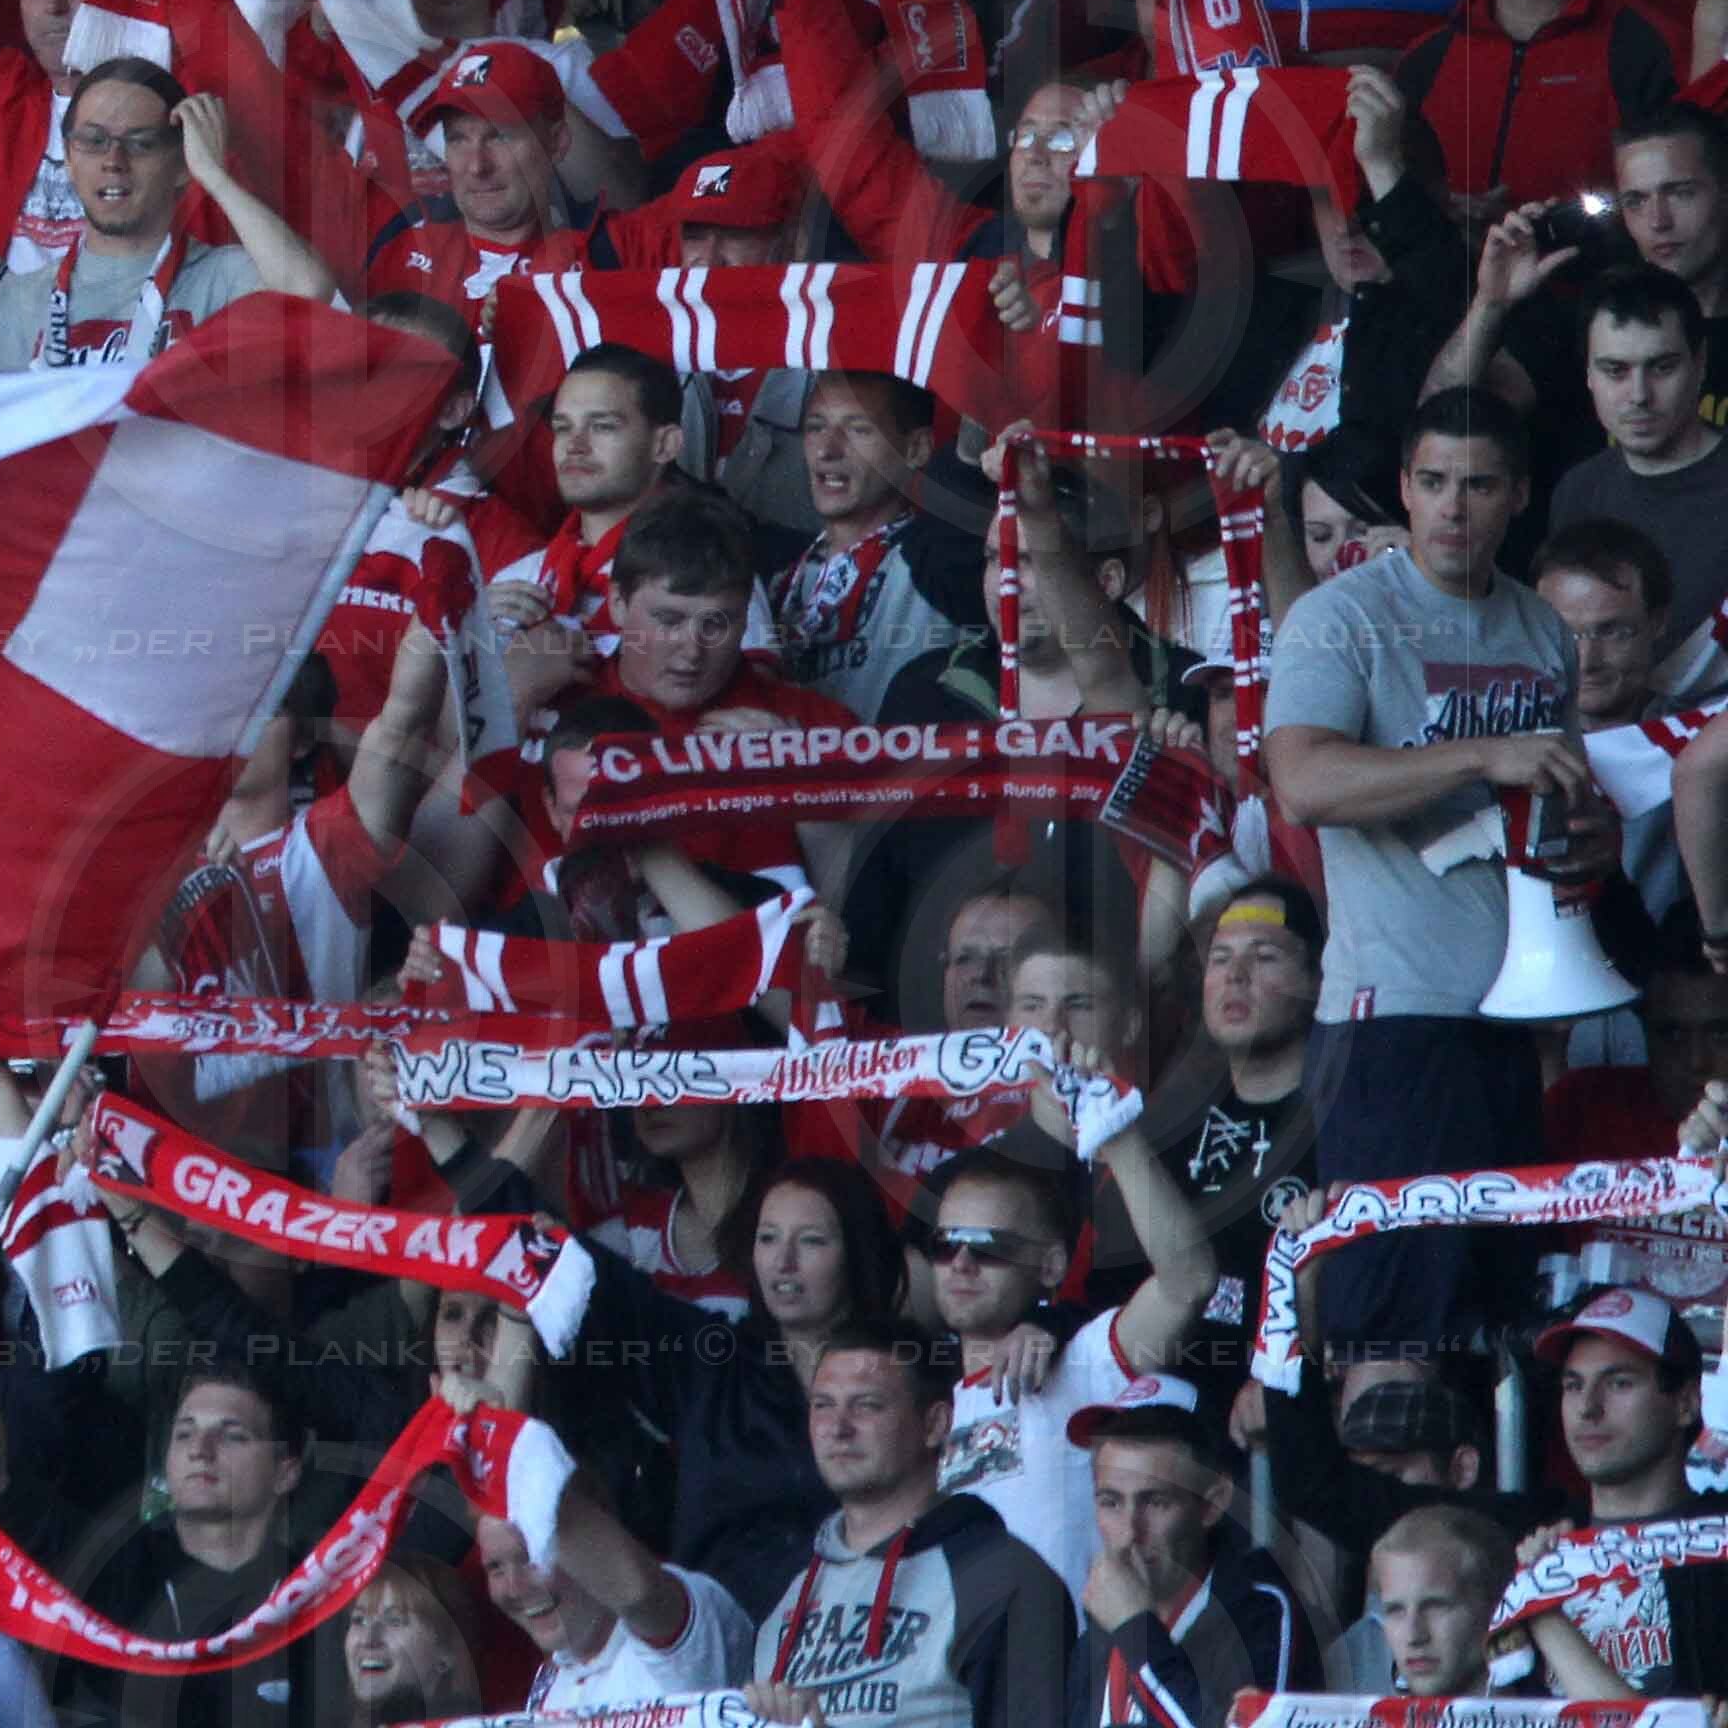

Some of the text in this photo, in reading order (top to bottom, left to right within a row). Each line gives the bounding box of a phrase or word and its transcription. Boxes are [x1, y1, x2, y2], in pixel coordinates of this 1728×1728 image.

[651, 725, 952, 775] LIVERPOOL
[994, 720, 1133, 765] GAK
[579, 803, 689, 831] Champions
[706, 793, 777, 813] League
[1002, 782, 1058, 800] Runde
[392, 1039, 520, 1103] WE
[547, 1046, 734, 1108] ARE
[171, 1155, 488, 1270] GRAZER AK
[1333, 1174, 1519, 1230] ARE
